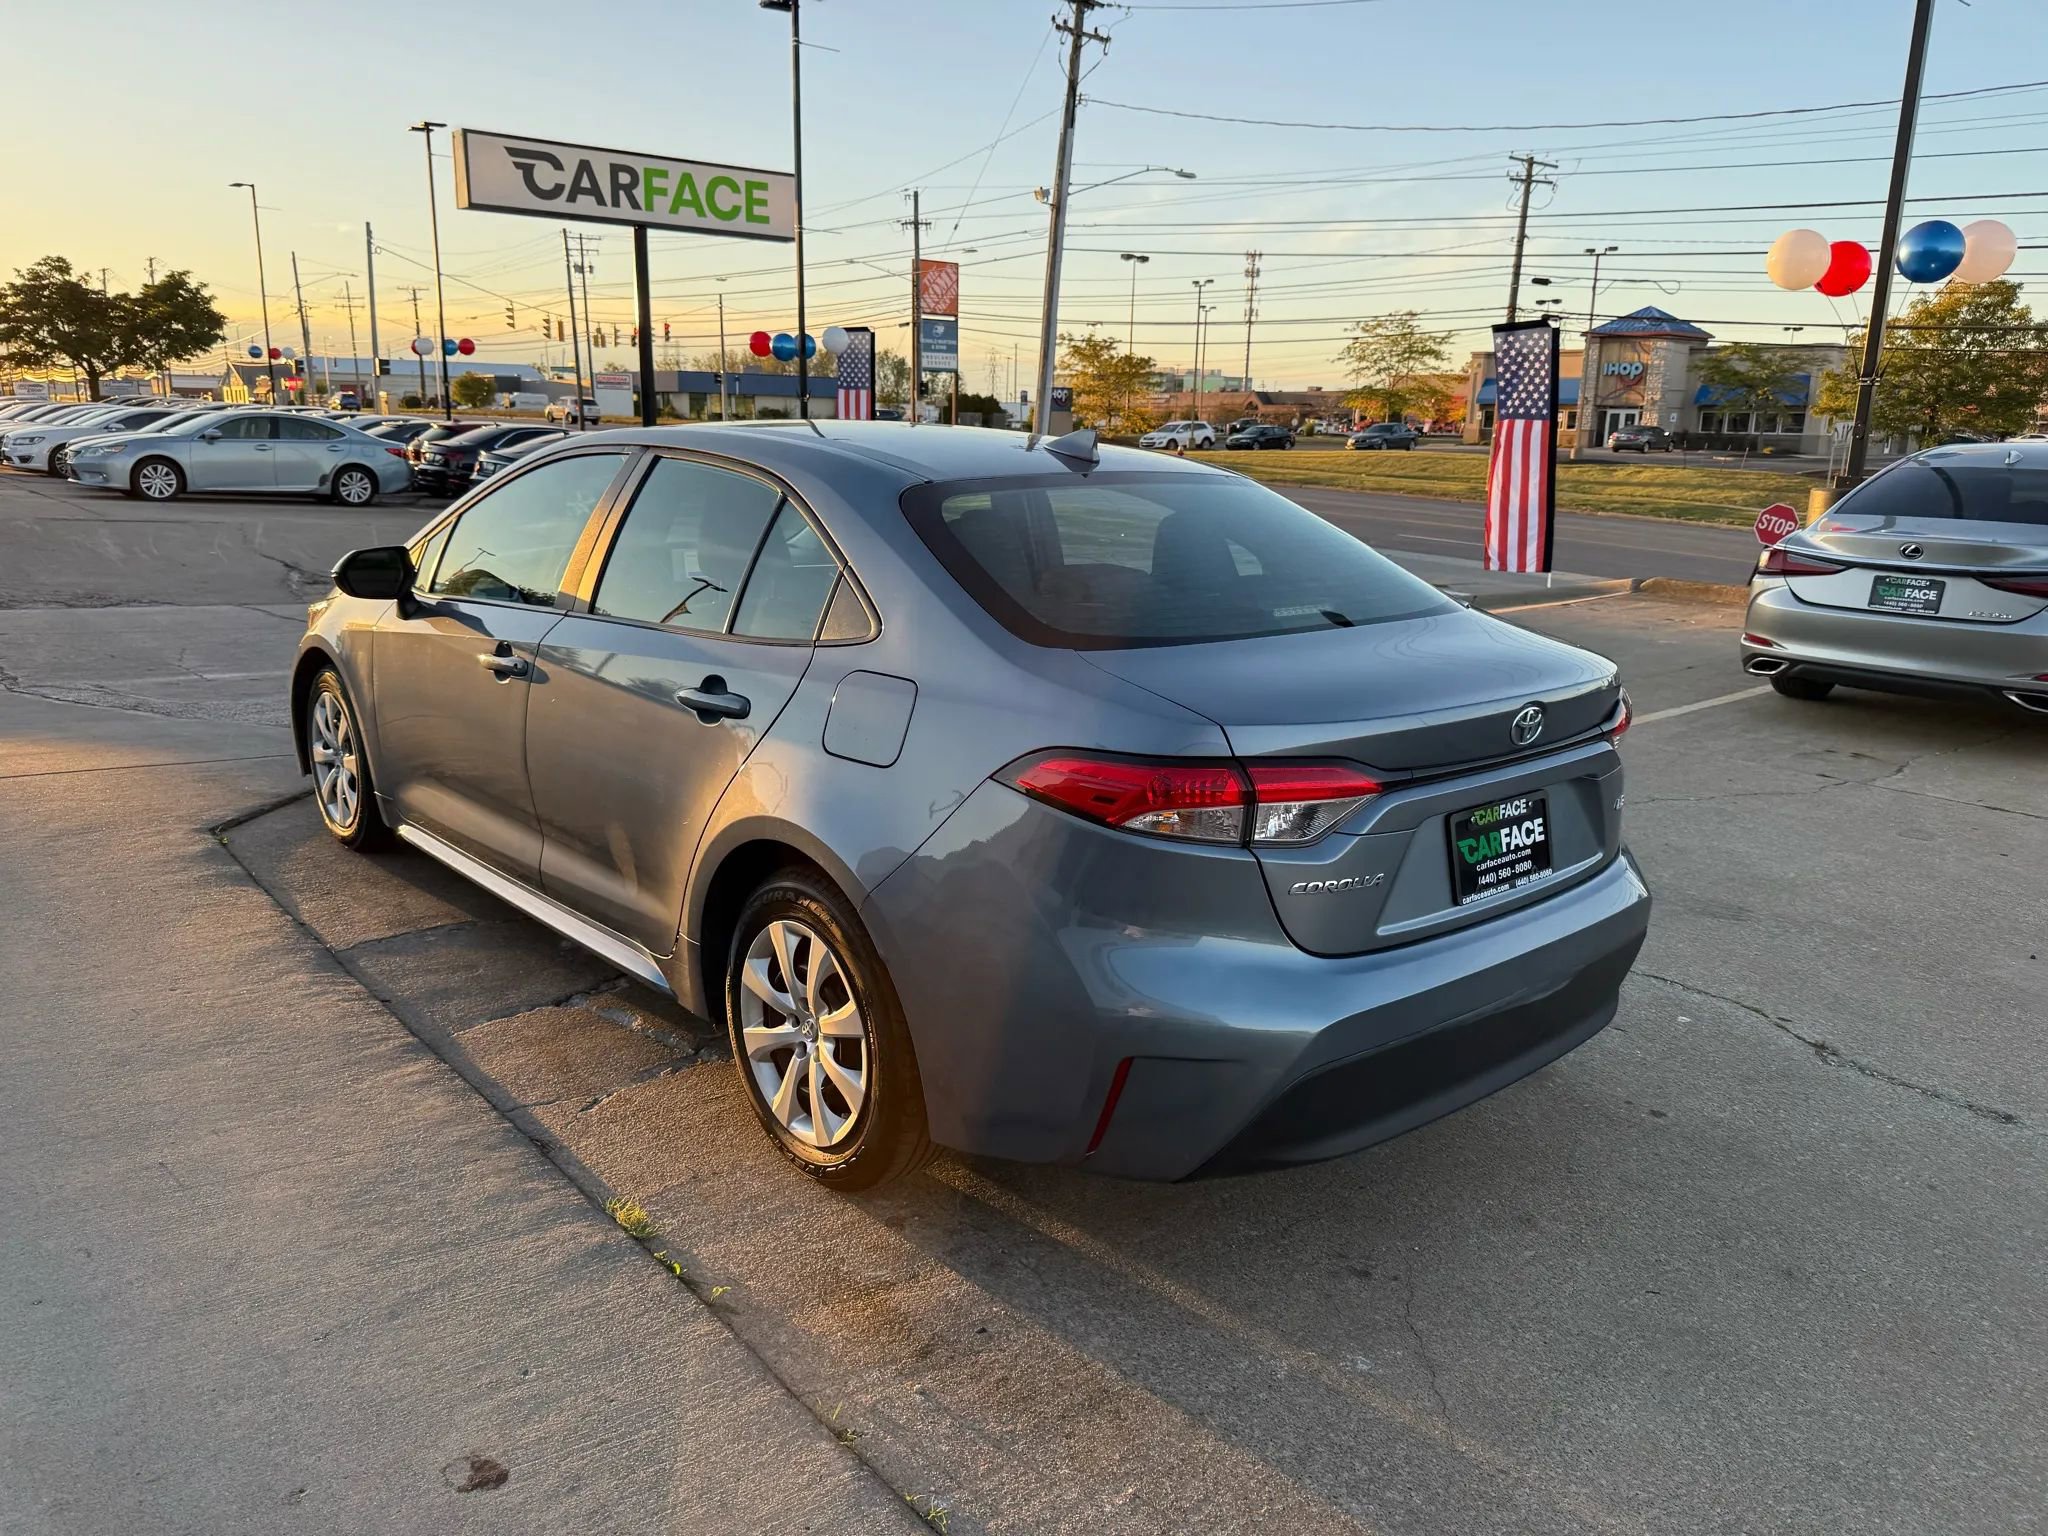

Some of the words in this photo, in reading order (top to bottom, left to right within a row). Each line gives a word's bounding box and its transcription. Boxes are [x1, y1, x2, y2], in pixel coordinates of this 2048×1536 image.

[503, 146, 770, 224] CARFACE
[1603, 362, 1643, 380] IHOP
[1052, 389, 1068, 402] HOP
[1758, 514, 1795, 536] STOP
[1876, 585, 1938, 600] CARFACE
[1890, 577, 1927, 587] CARFACE
[1474, 798, 1527, 826] CARFACE
[1456, 817, 1545, 864] CARFACE
[1476, 848, 1532, 871] carfaceauto.com
[1288, 873, 1385, 895] COROLLA
[1478, 872, 1497, 885] (440)
[1462, 883, 1510, 904] carfaceauto.com
